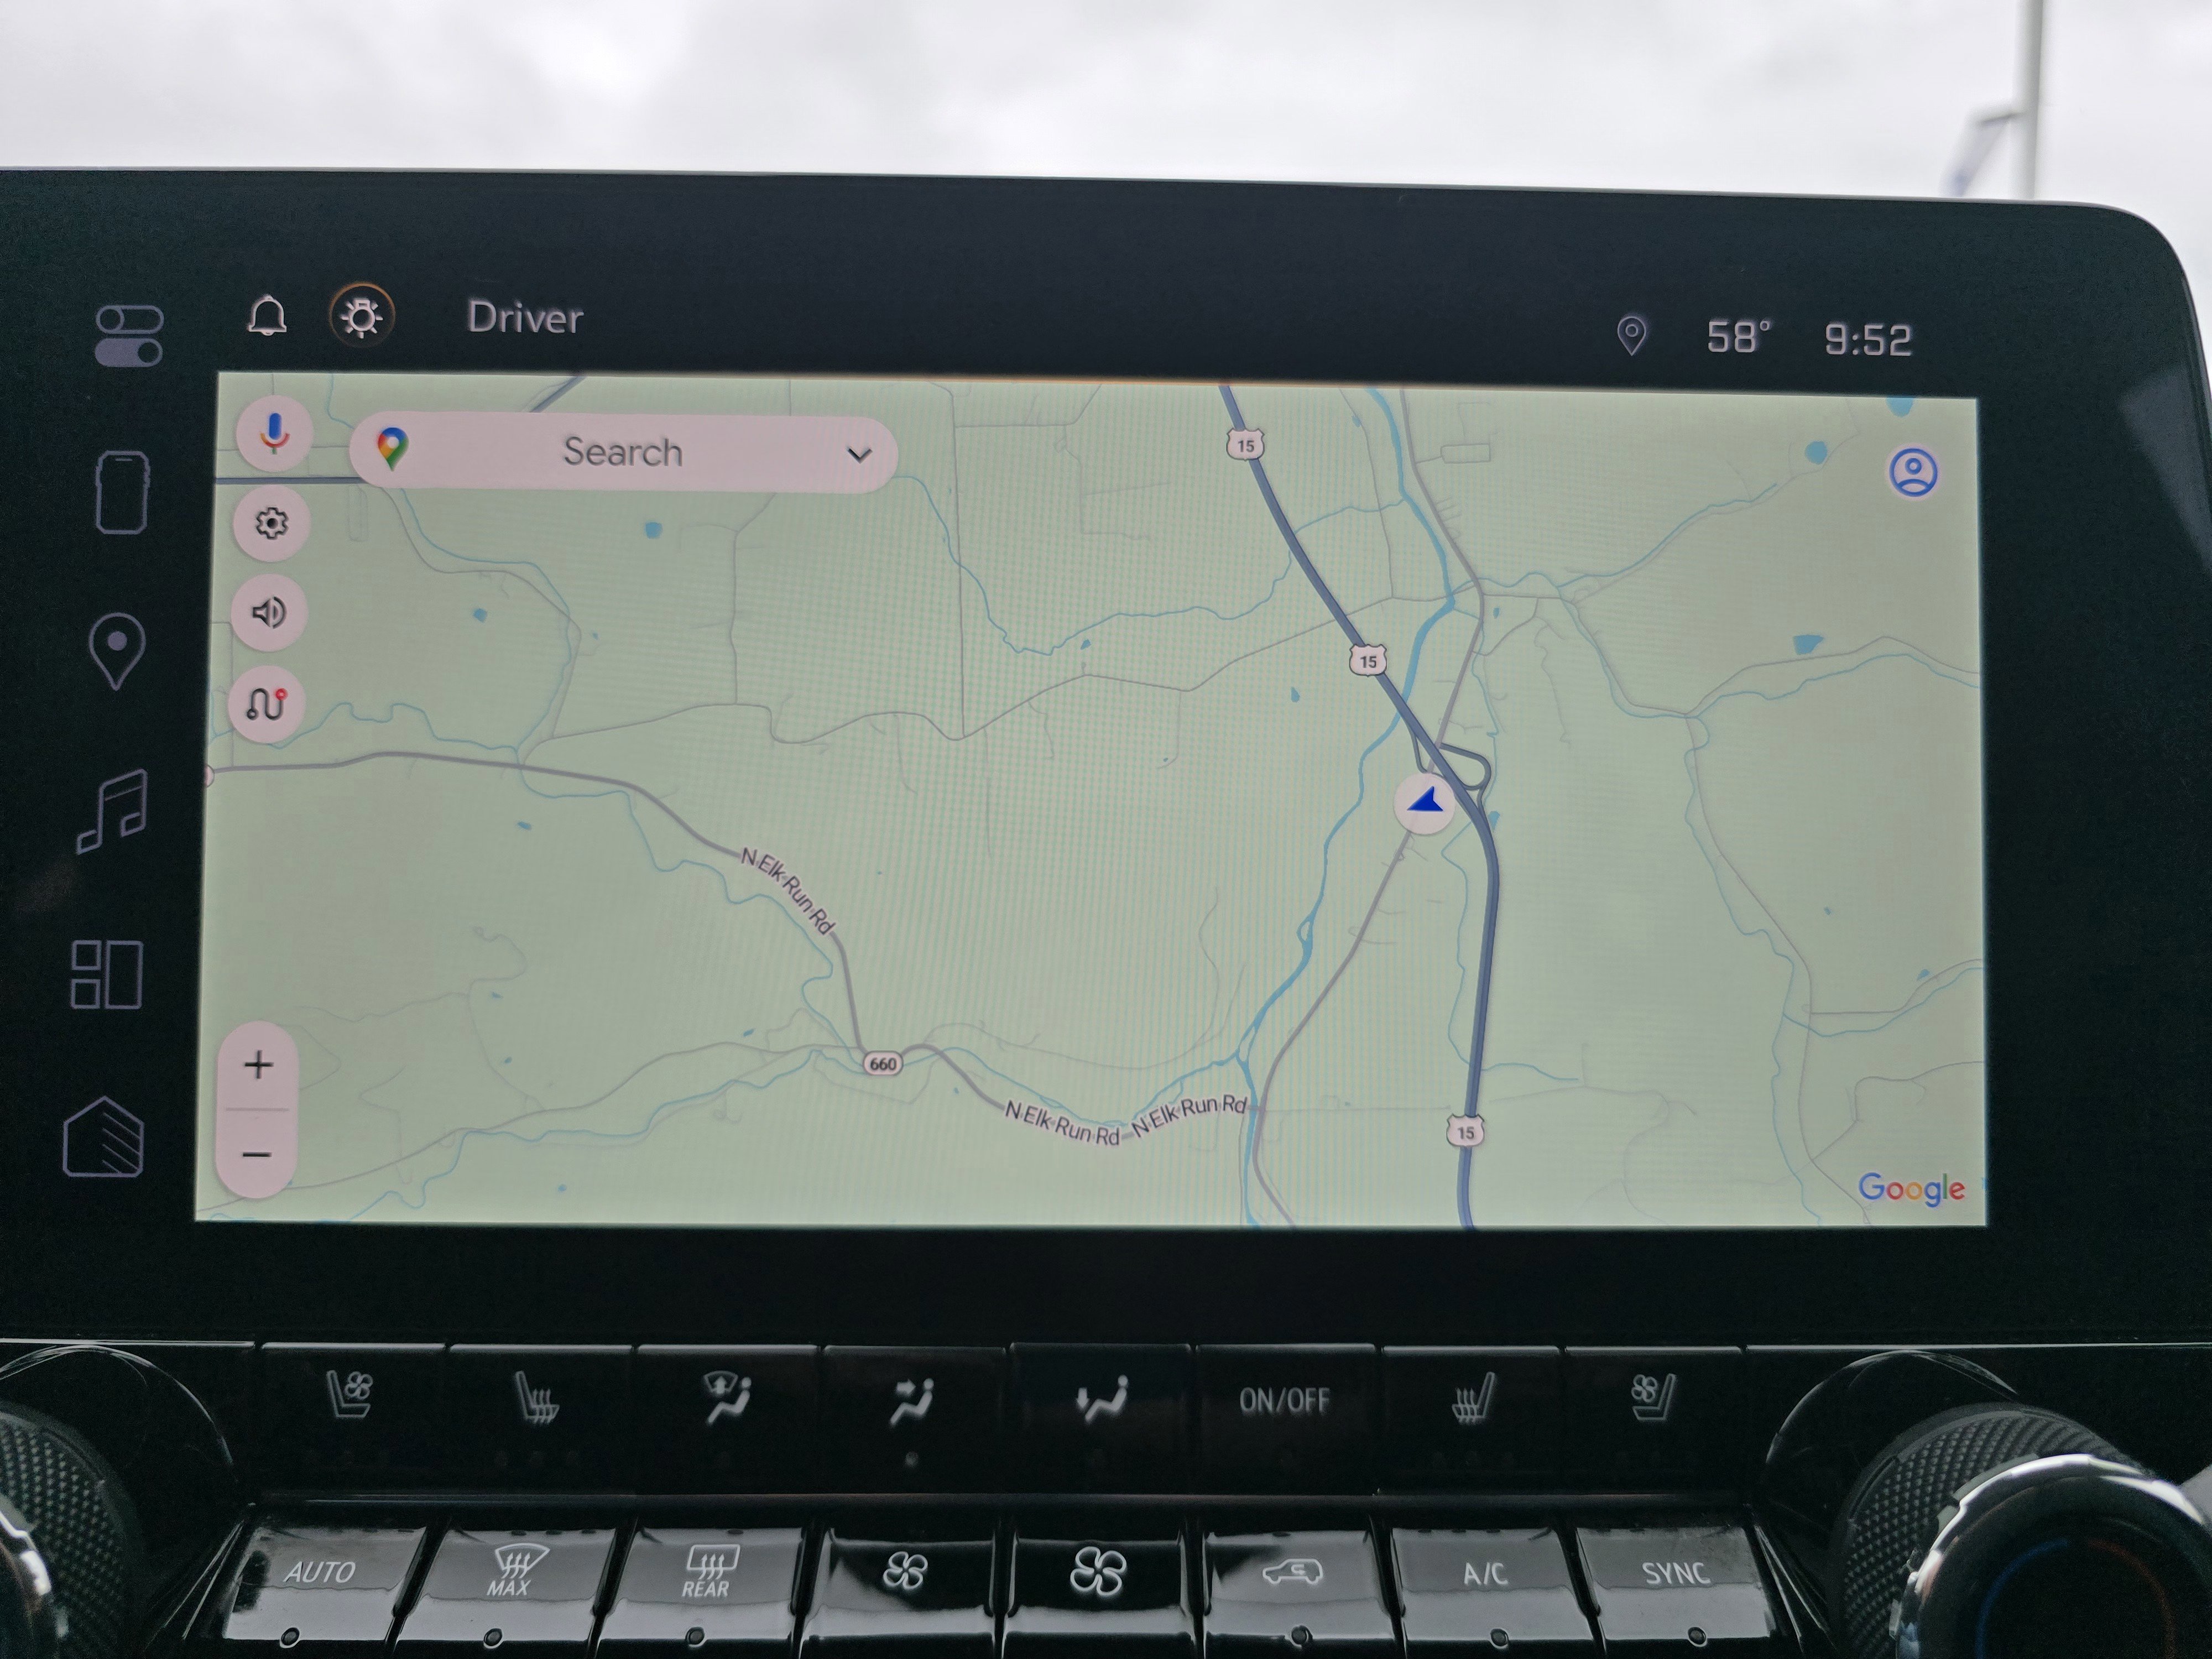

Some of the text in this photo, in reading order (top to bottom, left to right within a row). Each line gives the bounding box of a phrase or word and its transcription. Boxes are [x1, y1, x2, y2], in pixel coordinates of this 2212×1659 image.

[468, 299, 585, 334] Driver
[1708, 320, 1770, 353] 58°
[1825, 323, 1912, 357] 9:52
[564, 436, 682, 467] Search
[1237, 440, 1255, 453] 15
[1359, 655, 1377, 669] 15
[741, 847, 836, 936] N Elk Run Rd
[870, 1057, 898, 1071] 660
[1005, 1100, 1120, 1145] N Elk Run Rd
[1131, 1094, 1248, 1138] N Elk Run Rd
[1457, 1126, 1474, 1140] 15
[1858, 1172, 1965, 1208] Google
[1239, 1387, 1330, 1413] ON/OFF
[283, 1561, 356, 1583] AUTO
[1463, 1562, 1508, 1586] A/C
[1642, 1561, 1712, 1585] SYNC
[486, 1580, 532, 1597] MAX
[681, 1580, 730, 1598] REAR
